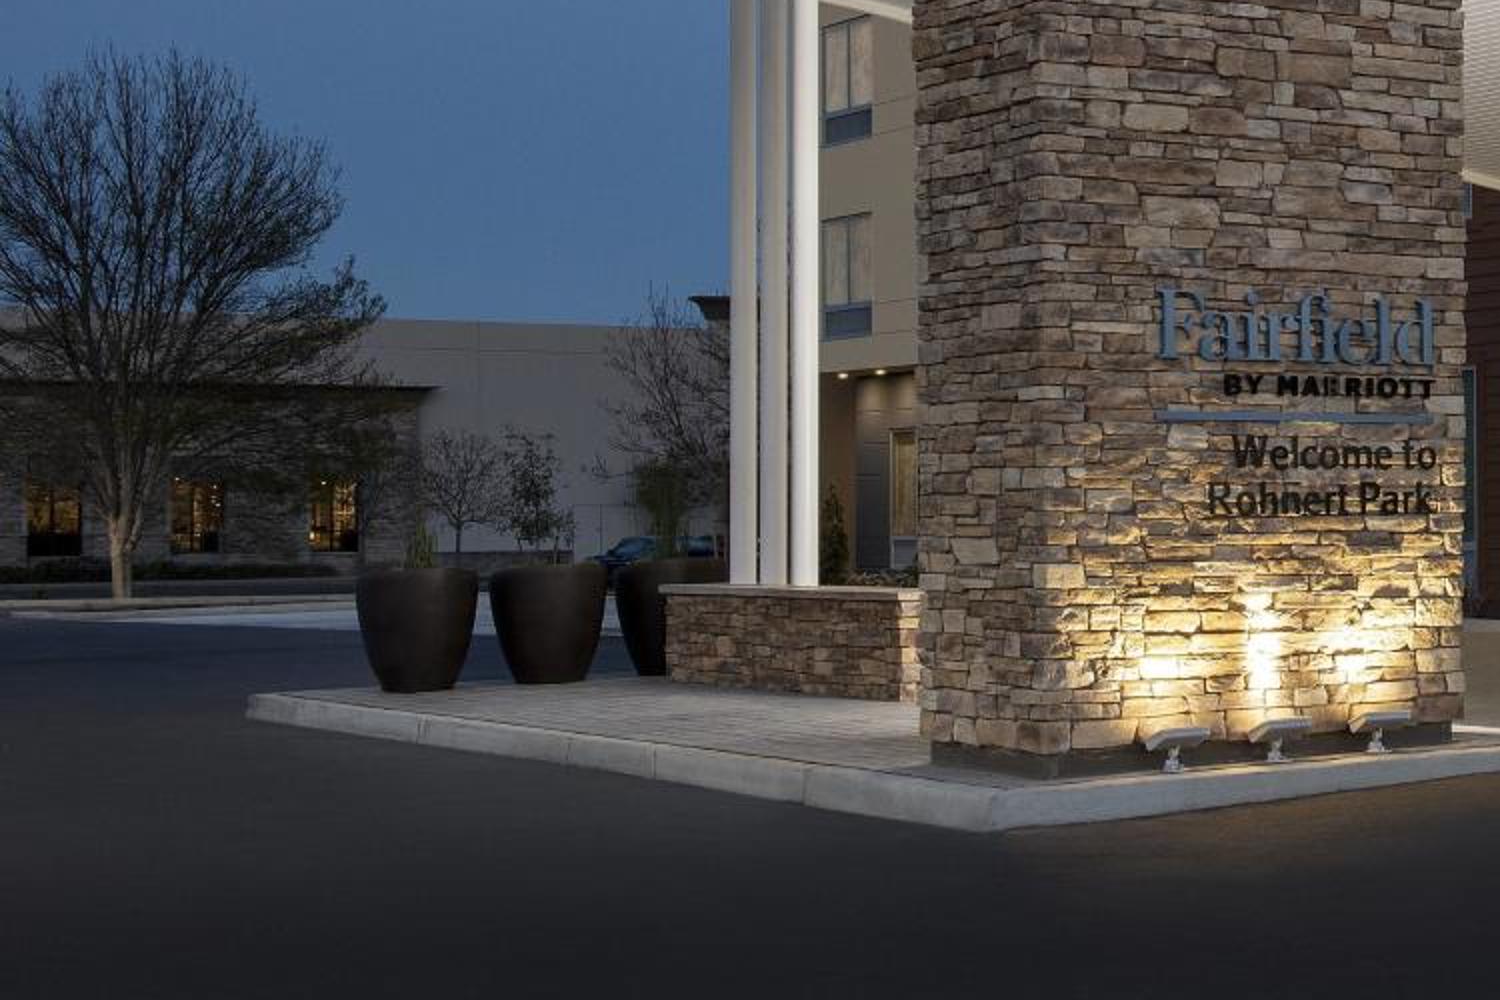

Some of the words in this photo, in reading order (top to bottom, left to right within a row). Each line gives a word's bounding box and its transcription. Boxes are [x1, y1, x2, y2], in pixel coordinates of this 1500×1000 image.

[1155, 287, 1435, 367] Fairfield
[1223, 373, 1263, 396] BY
[1277, 374, 1437, 399] MARRIOTT
[1232, 434, 1393, 470] Welcome
[1400, 438, 1437, 470] to
[1207, 481, 1350, 516] Rohnert
[1360, 481, 1438, 516] Park
